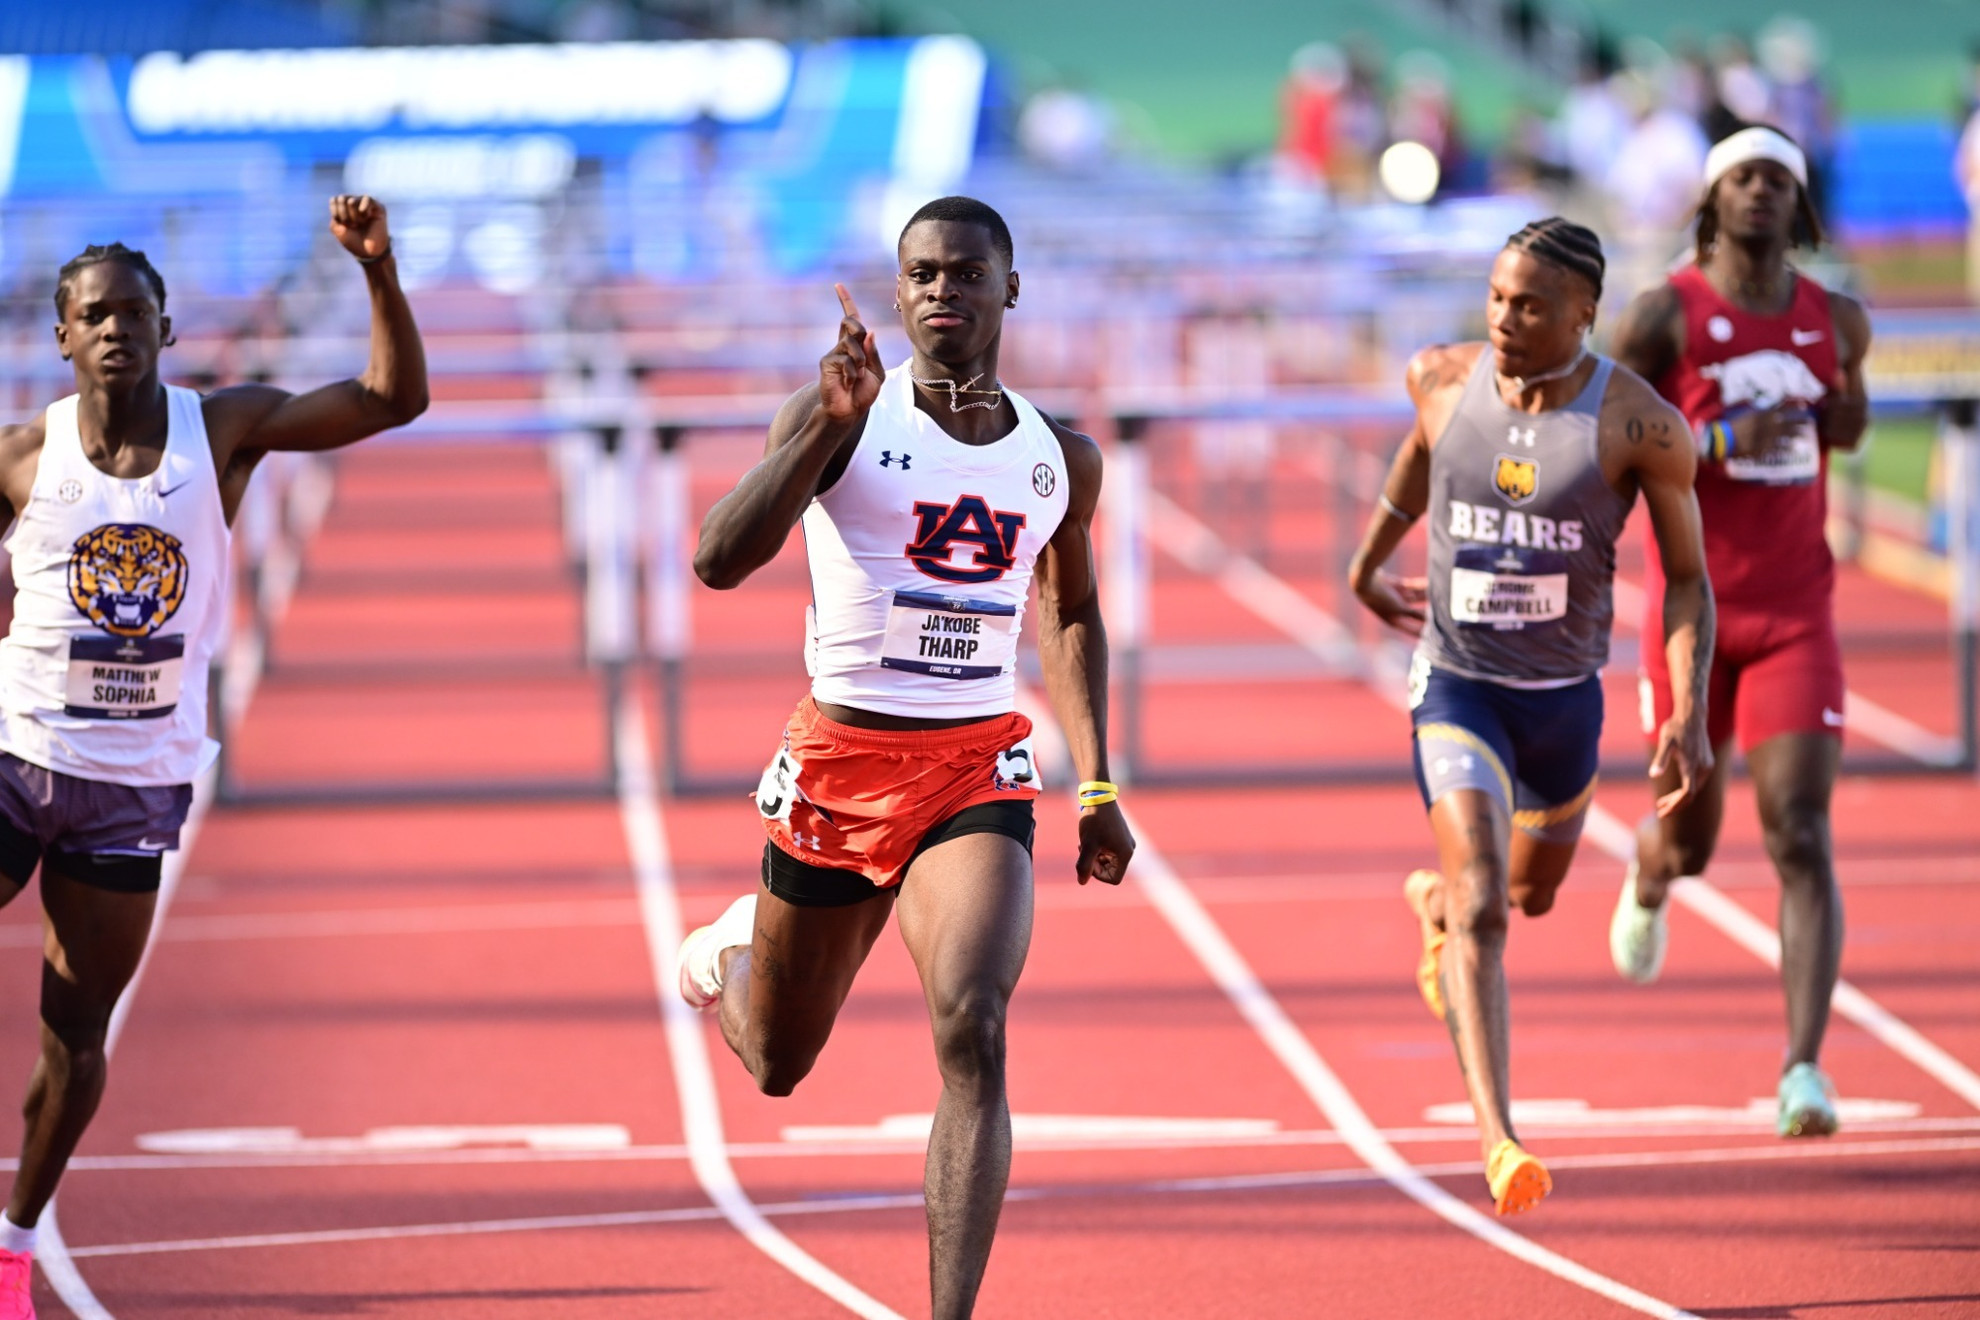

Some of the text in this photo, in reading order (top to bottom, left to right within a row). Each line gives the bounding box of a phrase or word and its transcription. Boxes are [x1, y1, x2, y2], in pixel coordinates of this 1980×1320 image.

[1033, 463, 1055, 497] SEC
[1449, 500, 1583, 551] BEARS
[1465, 597, 1552, 615] CAMPBELL
[921, 614, 982, 635] JA'KOBE
[918, 635, 979, 661] THARP
[92, 666, 162, 684] MATTHEW
[92, 684, 157, 704] SOPHIA
